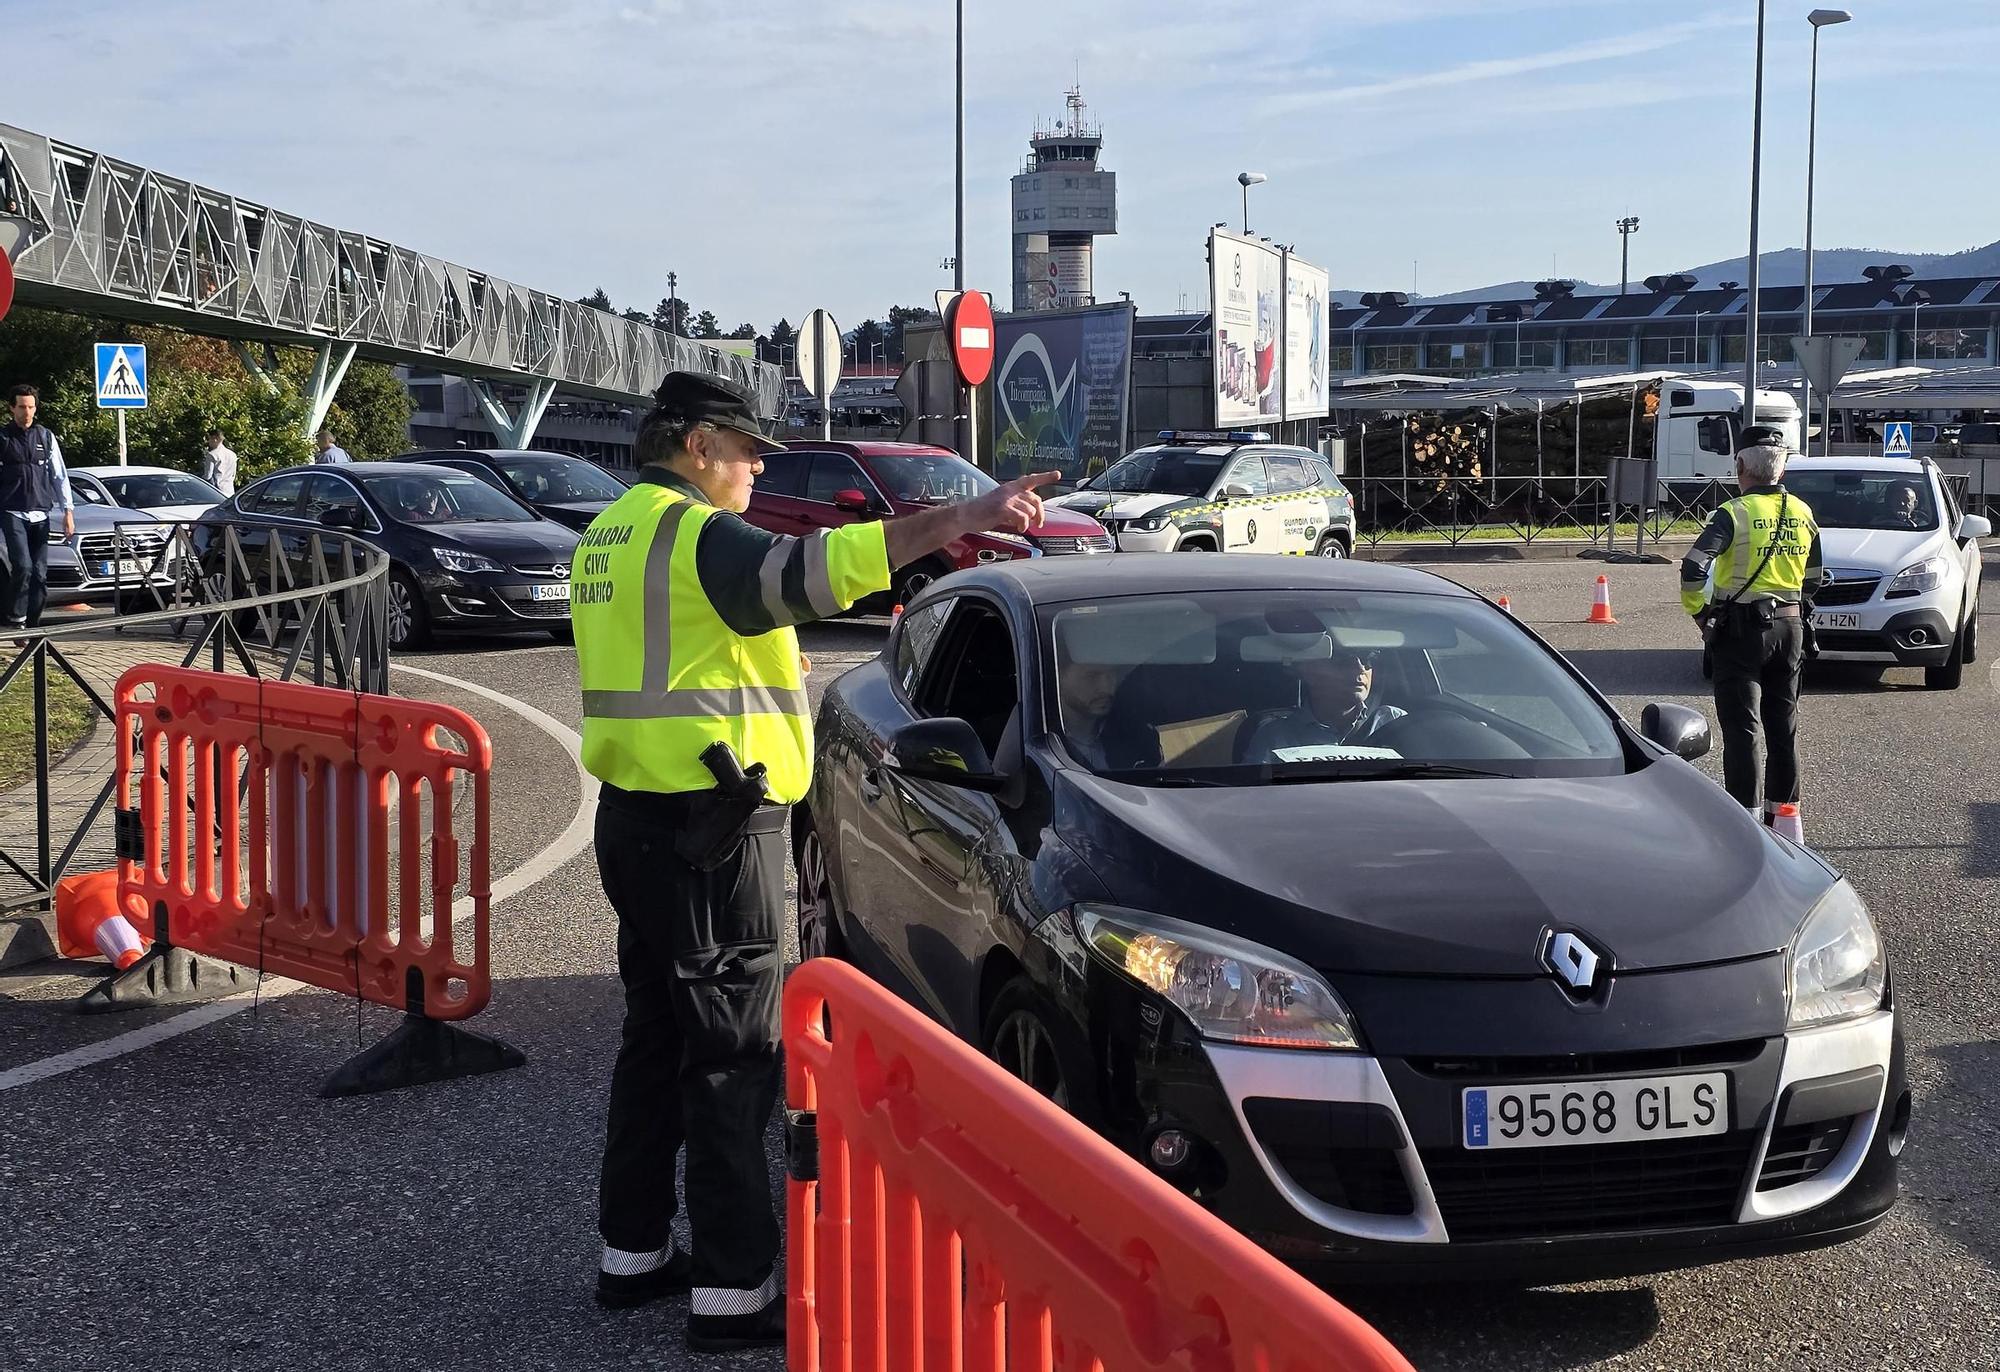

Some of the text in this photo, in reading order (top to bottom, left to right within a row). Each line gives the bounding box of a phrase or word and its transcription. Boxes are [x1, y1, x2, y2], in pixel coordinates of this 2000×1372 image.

[580, 524, 634, 547] GUARDIA
[1769, 530, 1797, 541] CVIL
[584, 552, 610, 575] CIVIL
[540, 586, 566, 598] 5040
[1830, 614, 1856, 627] HZN
[1473, 1082, 1716, 1139] E 9568 GLS
